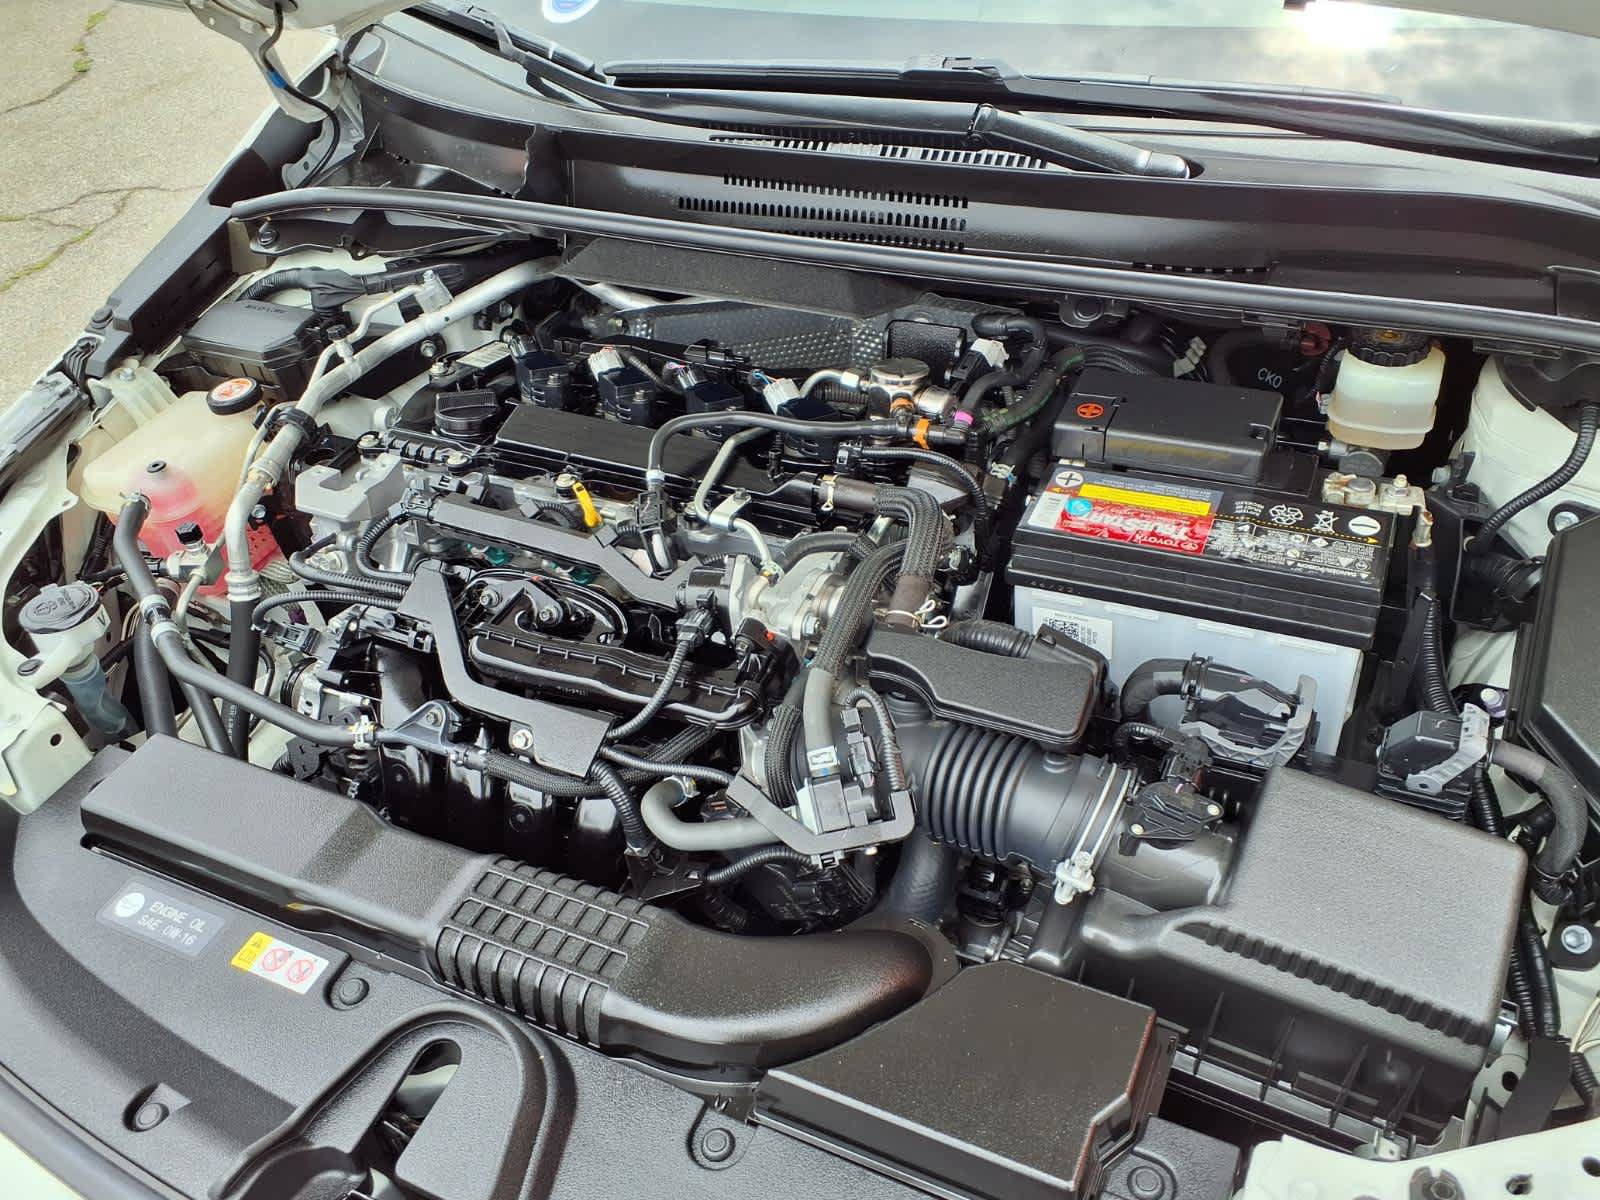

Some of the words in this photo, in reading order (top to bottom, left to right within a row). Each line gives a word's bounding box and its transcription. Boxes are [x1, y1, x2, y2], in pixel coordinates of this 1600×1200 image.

[1134, 531, 1180, 547] TOYOTA
[137, 914, 162, 931] SAE
[149, 901, 189, 924] ENGINE
[189, 918, 207, 933] OIL
